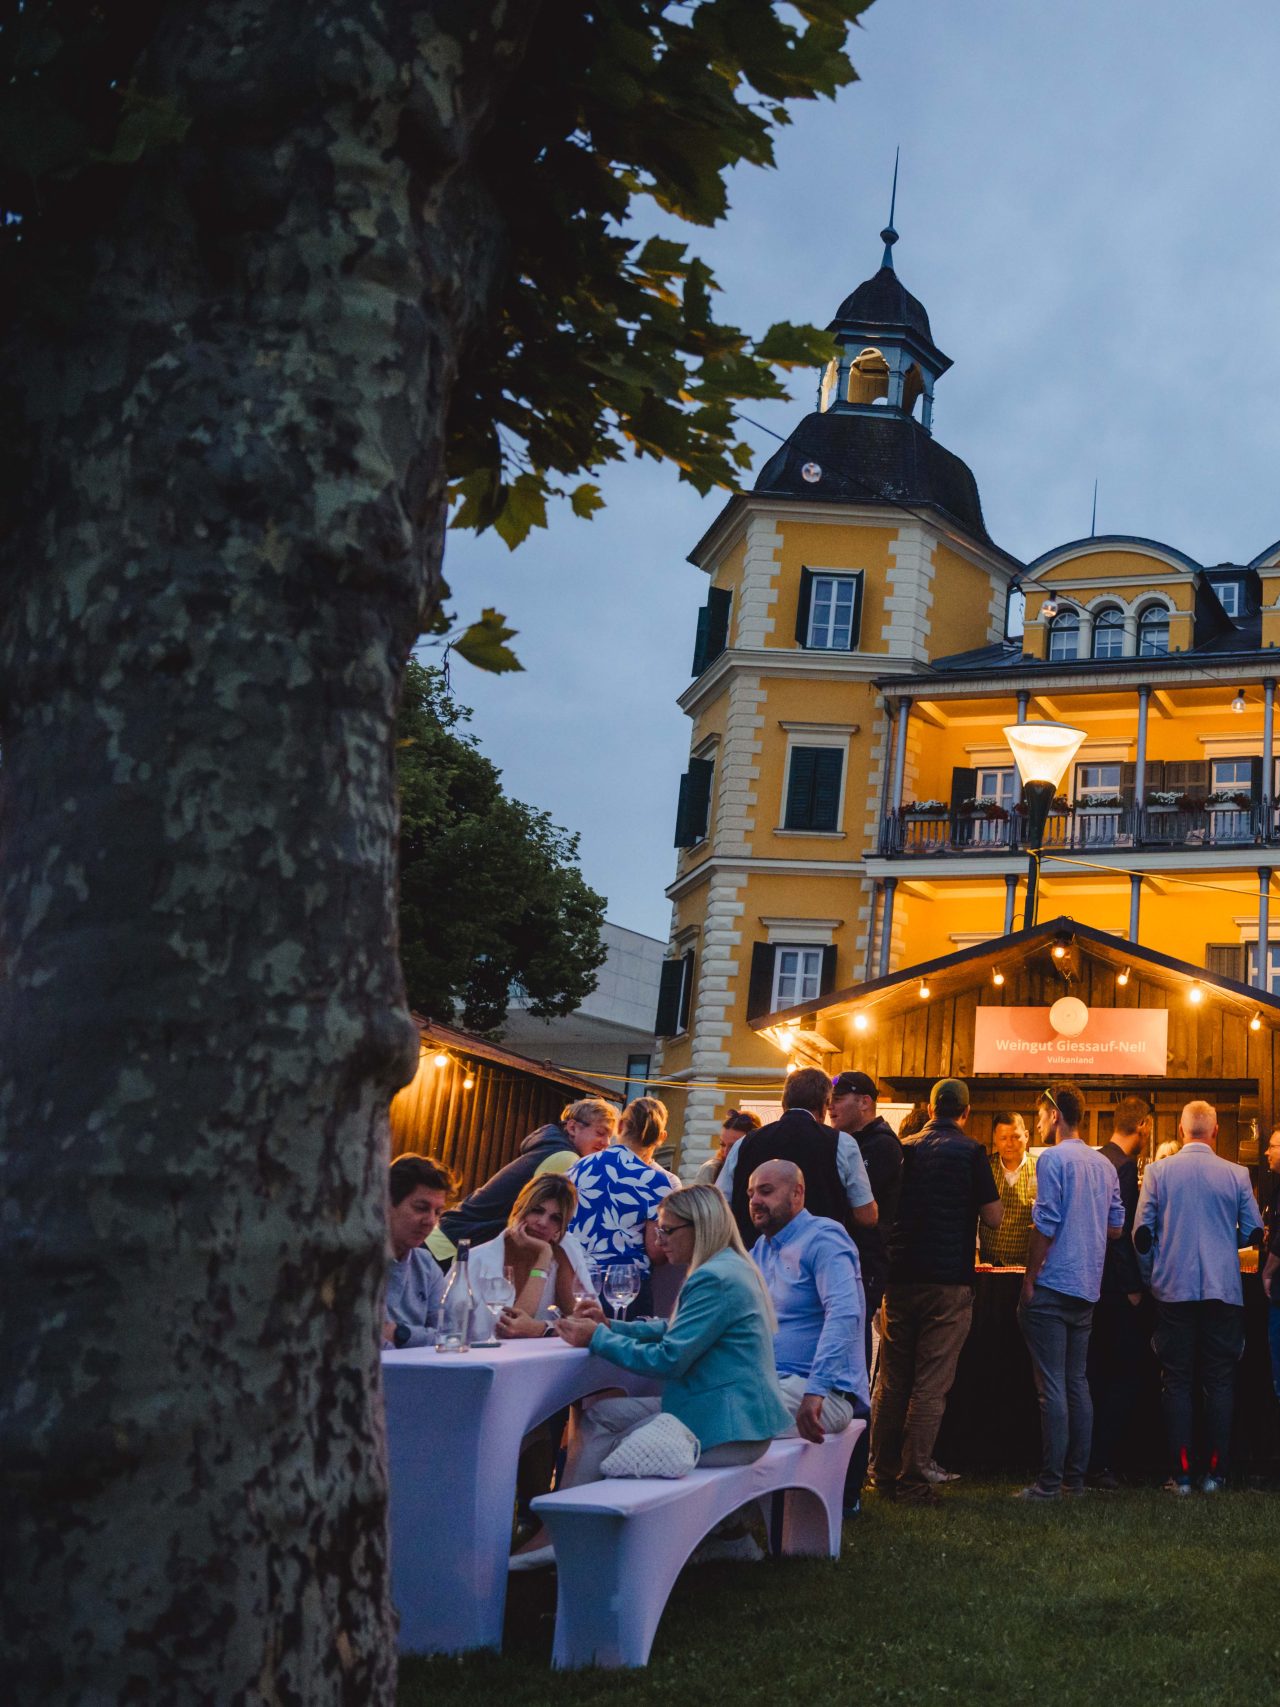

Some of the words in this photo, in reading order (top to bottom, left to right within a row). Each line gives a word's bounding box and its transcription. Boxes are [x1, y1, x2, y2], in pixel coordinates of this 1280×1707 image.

[996, 1039, 1052, 1054] Weingut
[1056, 1040, 1146, 1053] Giessauf-Nell
[1047, 1055, 1094, 1064] Vulkanland
